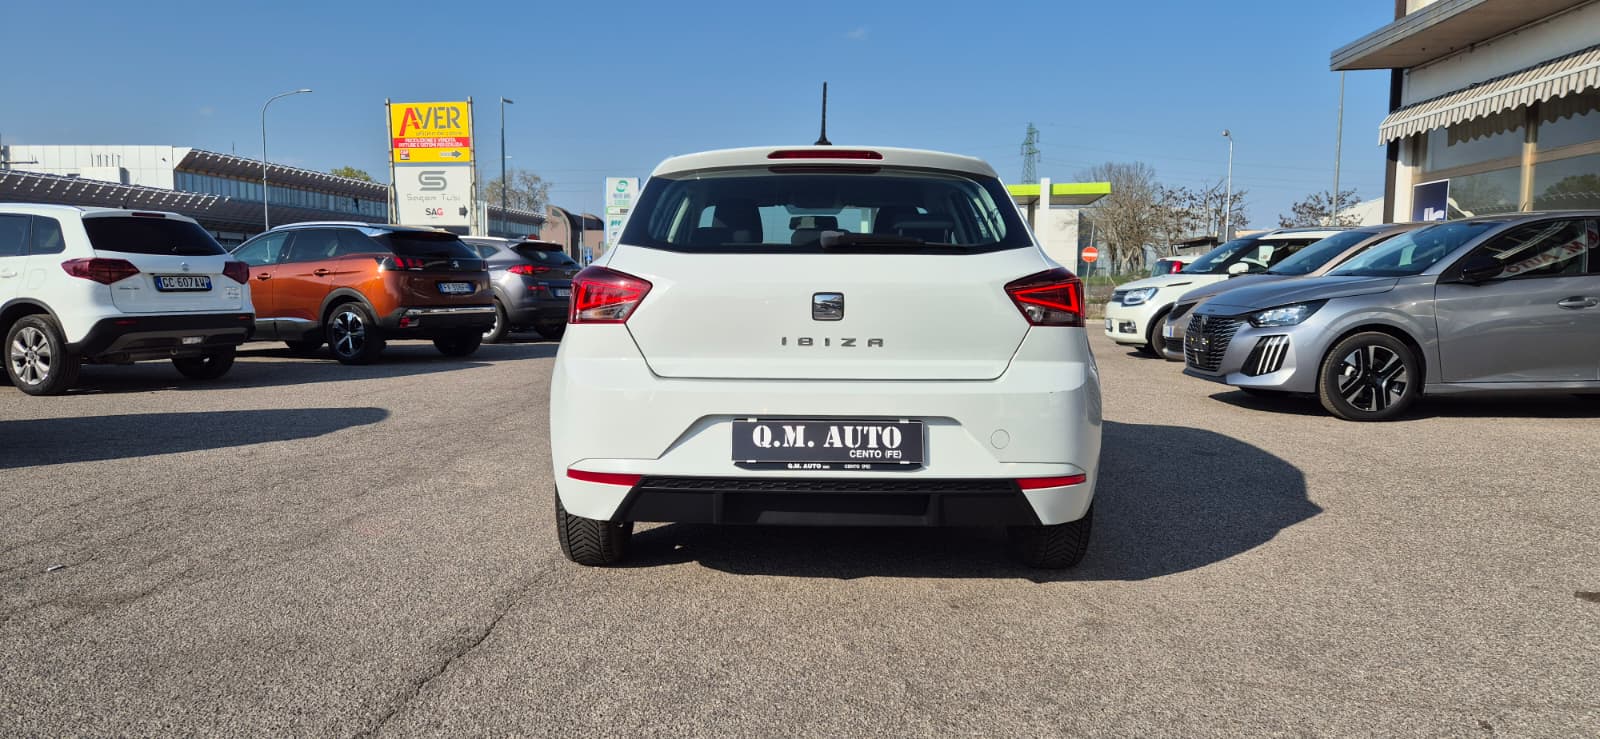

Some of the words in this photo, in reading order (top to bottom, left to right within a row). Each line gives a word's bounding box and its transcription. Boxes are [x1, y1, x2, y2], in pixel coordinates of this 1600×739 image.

[399, 106, 461, 136] AVER
[425, 207, 444, 216] SAG
[781, 336, 884, 347] IBIZA
[752, 424, 815, 448] Q.M.
[823, 425, 902, 449] AUTO
[849, 449, 882, 459] CENTO
[884, 449, 902, 459] (FE)
